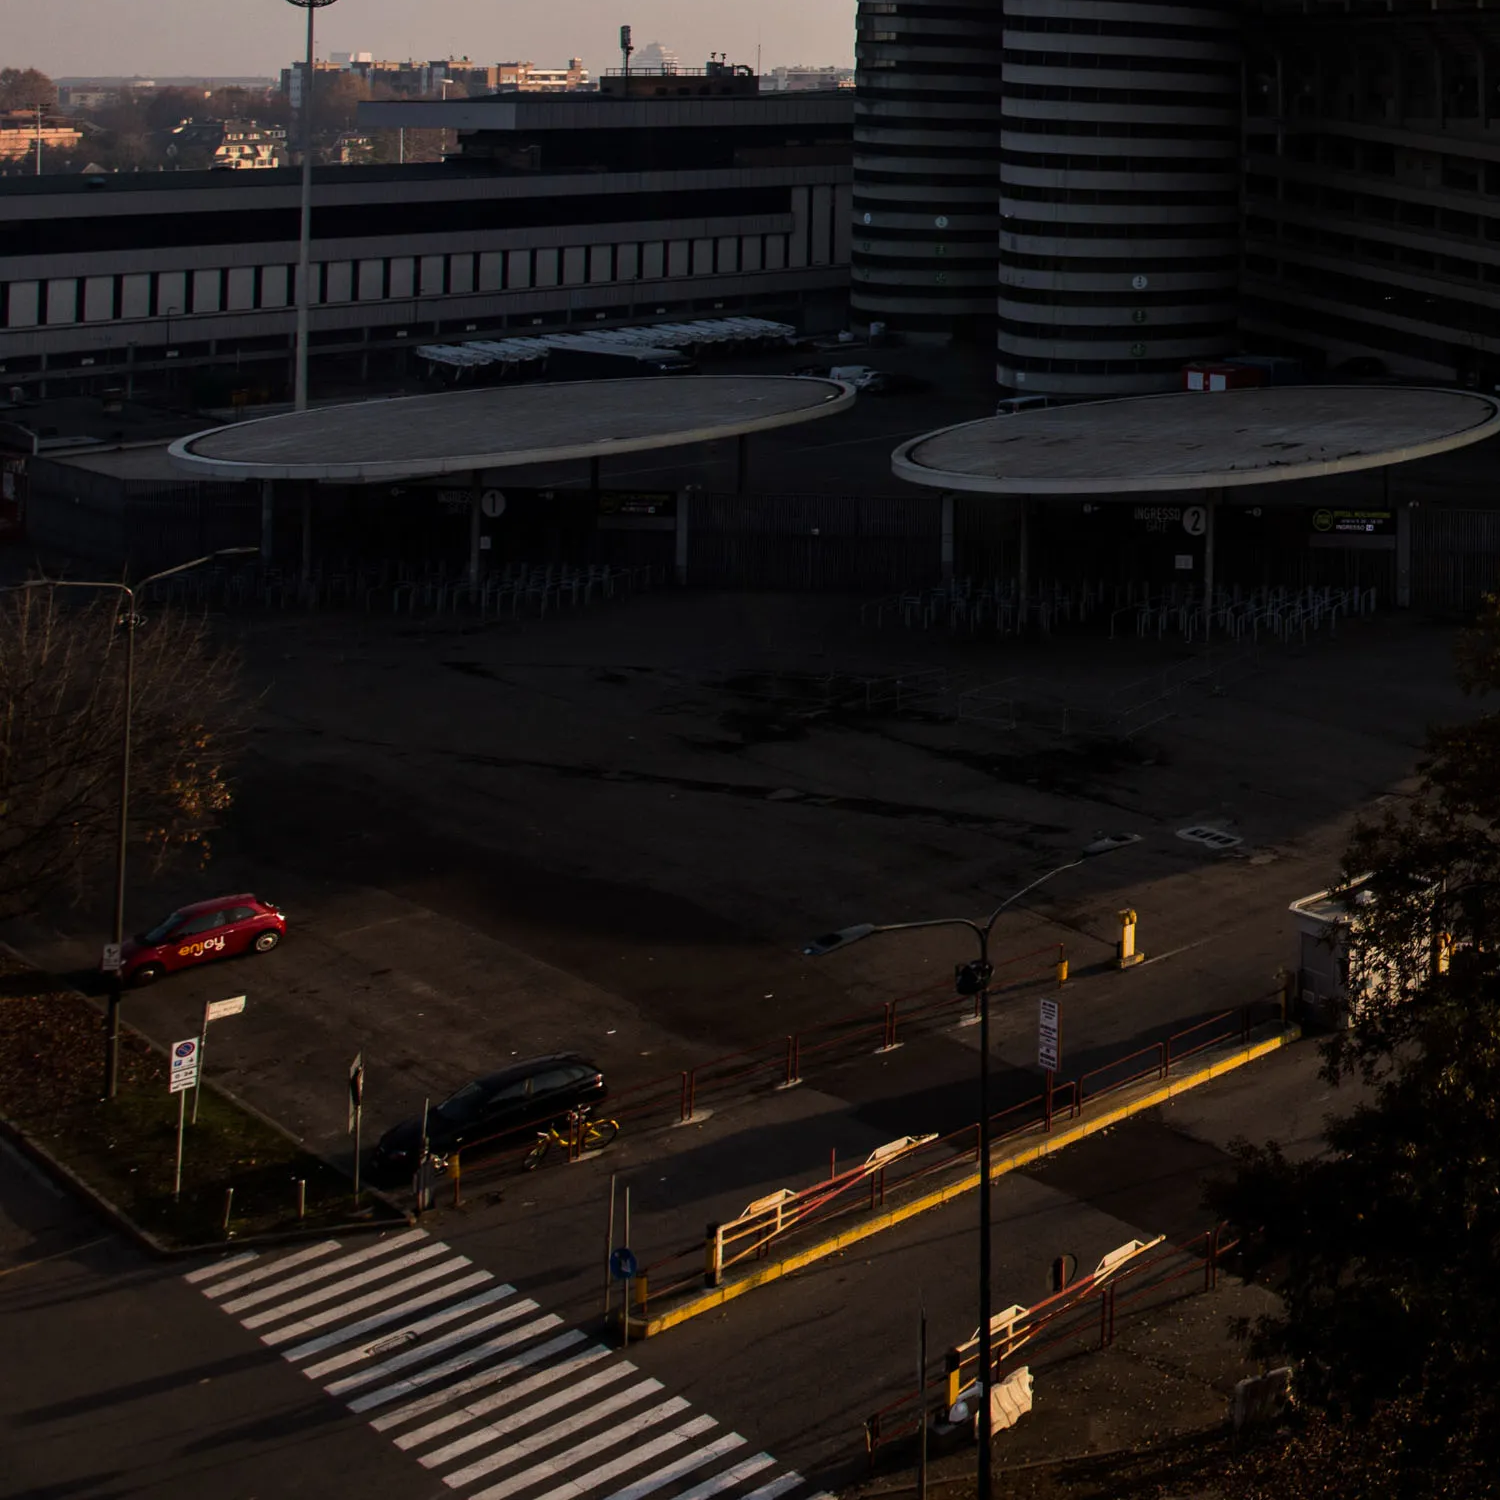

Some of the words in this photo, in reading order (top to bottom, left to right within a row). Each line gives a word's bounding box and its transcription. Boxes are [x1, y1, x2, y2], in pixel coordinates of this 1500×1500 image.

[1134, 506, 1181, 521] INGRESSO
[1191, 510, 1201, 531] 2
[178, 935, 225, 956] enjoy
